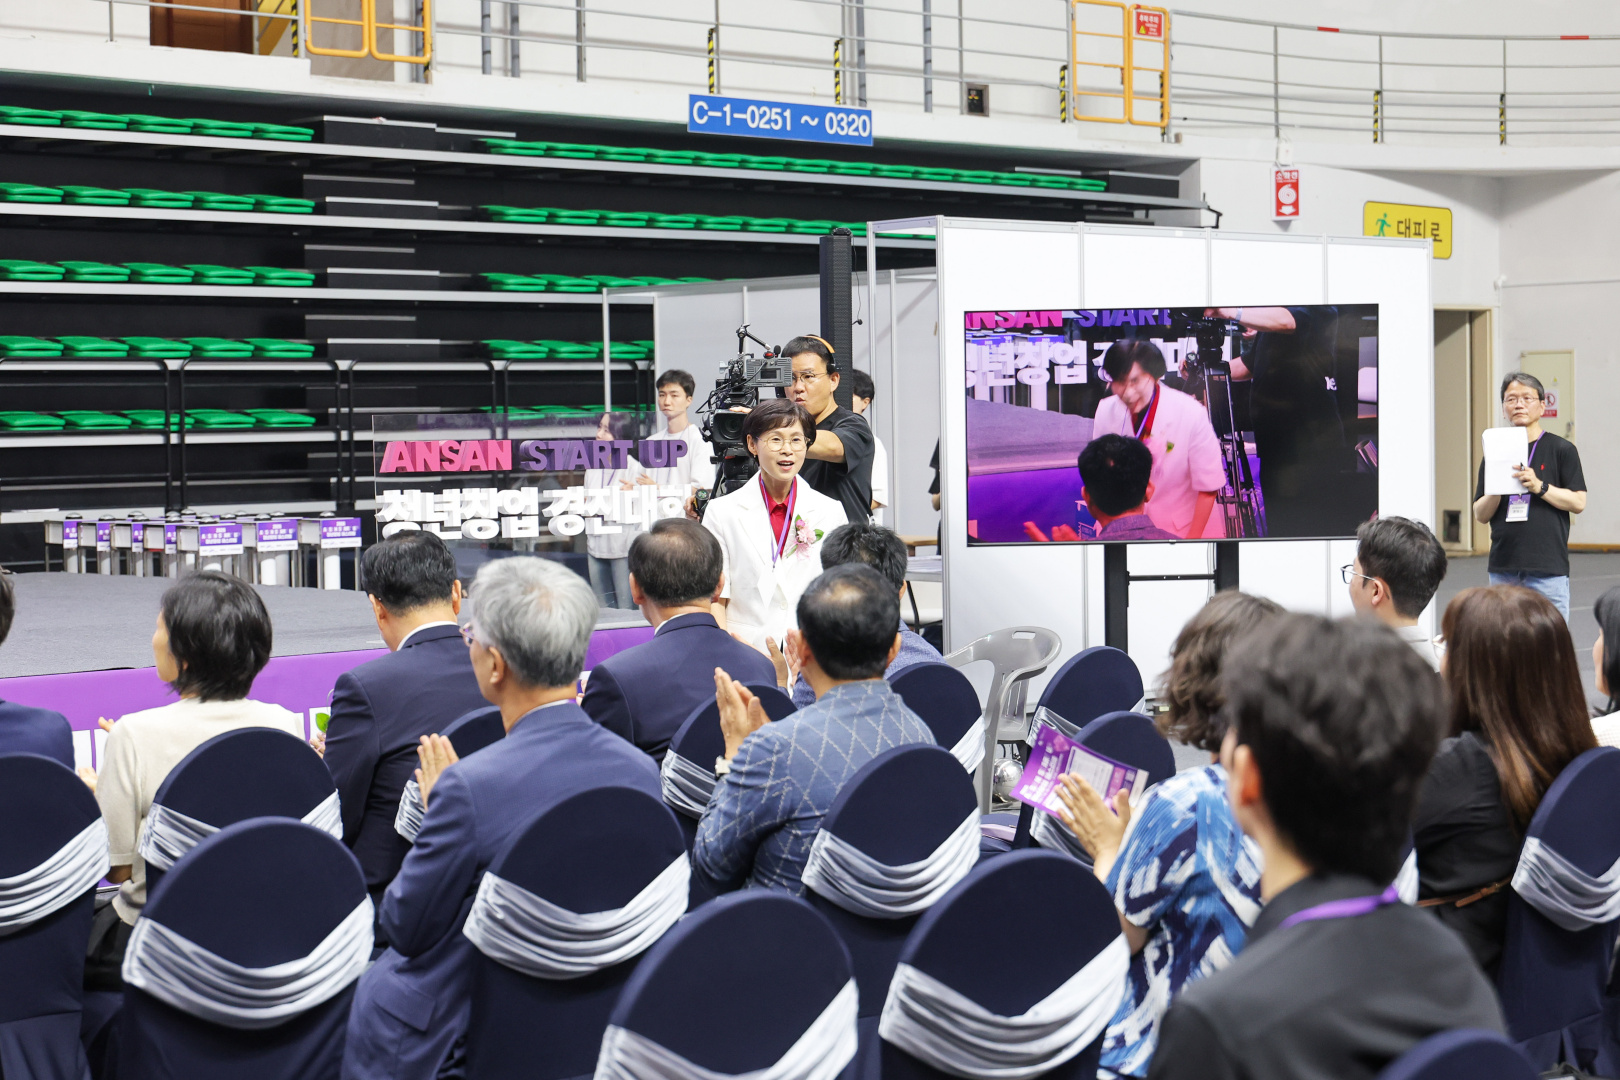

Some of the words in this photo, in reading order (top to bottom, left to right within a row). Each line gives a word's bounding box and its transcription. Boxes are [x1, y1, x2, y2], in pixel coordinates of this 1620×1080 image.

[692, 101, 792, 131] C-1-0251
[824, 111, 871, 138] 0320
[1396, 218, 1443, 243] 대피로
[379, 440, 513, 473] ANSAN
[520, 439, 633, 471] START
[638, 439, 688, 468] UP
[375, 487, 540, 540] 청년창업
